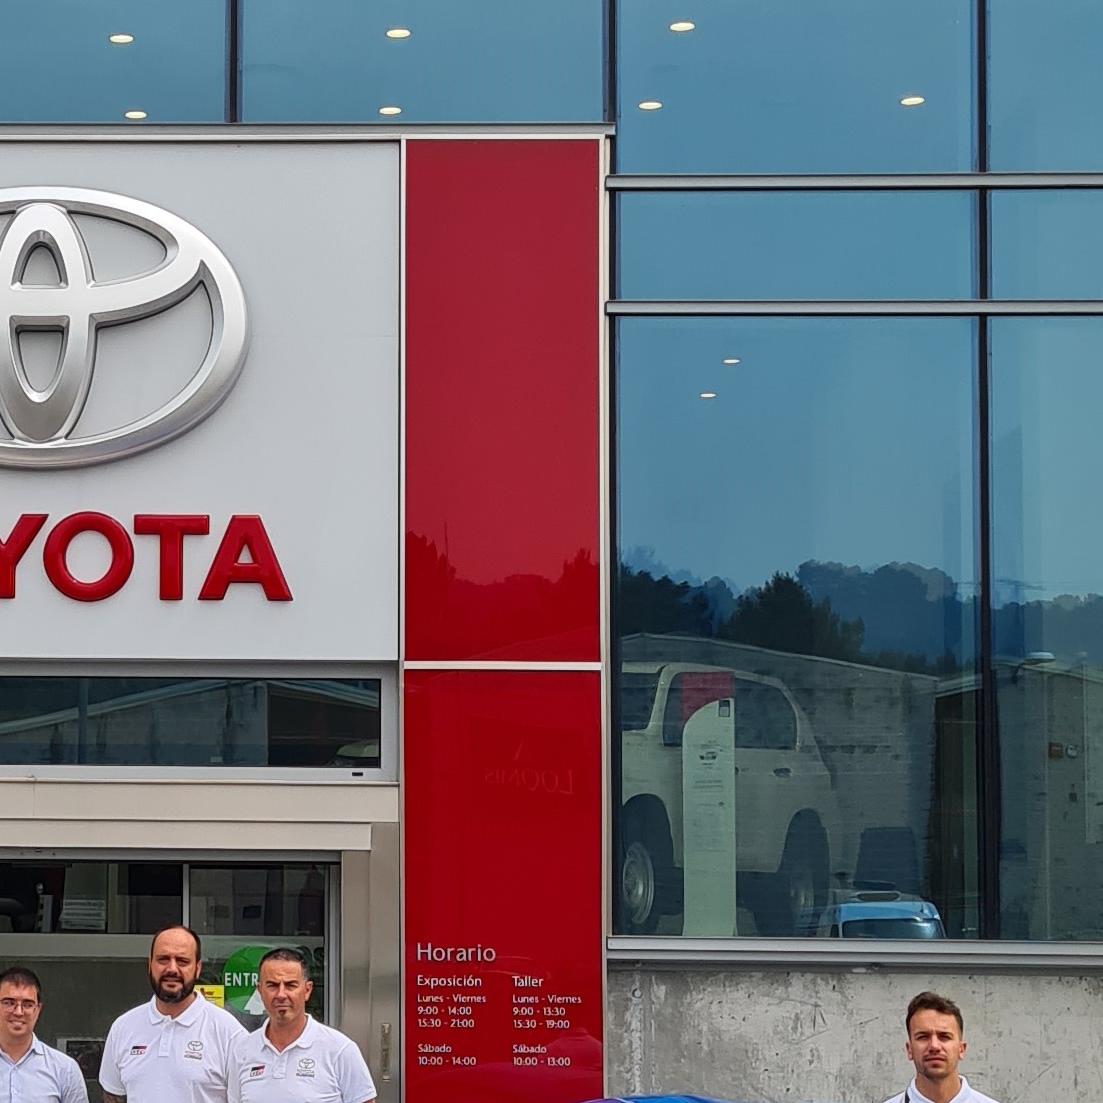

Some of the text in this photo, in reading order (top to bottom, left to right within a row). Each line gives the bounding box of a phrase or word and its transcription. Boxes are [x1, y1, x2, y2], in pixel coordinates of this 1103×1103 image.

[416, 942, 497, 962] Horario
[224, 972, 259, 987] ENTR
[416, 974, 482, 990] Exposición
[511, 975, 545, 988] Taller
[417, 993, 444, 1003] Lunes
[452, 993, 487, 1003] Viernes
[512, 994, 539, 1004] Lunes
[547, 994, 582, 1004] Viernes
[417, 1006, 439, 1015] 9:00
[448, 1006, 472, 1015] 14:00
[512, 1007, 534, 1016] 9:00
[543, 1007, 566, 1016] 13:30
[417, 1018, 442, 1028] 15:30
[450, 1018, 475, 1028] 21:00
[513, 1019, 537, 1029] 15:30
[545, 1019, 570, 1029] 19:00
[417, 1043, 452, 1053] Sábado
[512, 1044, 547, 1054] Sábado
[418, 1056, 443, 1066] 10:00
[452, 1056, 477, 1066] 14:00
[513, 1057, 538, 1067] 10:00
[547, 1057, 571, 1067] 13:00
